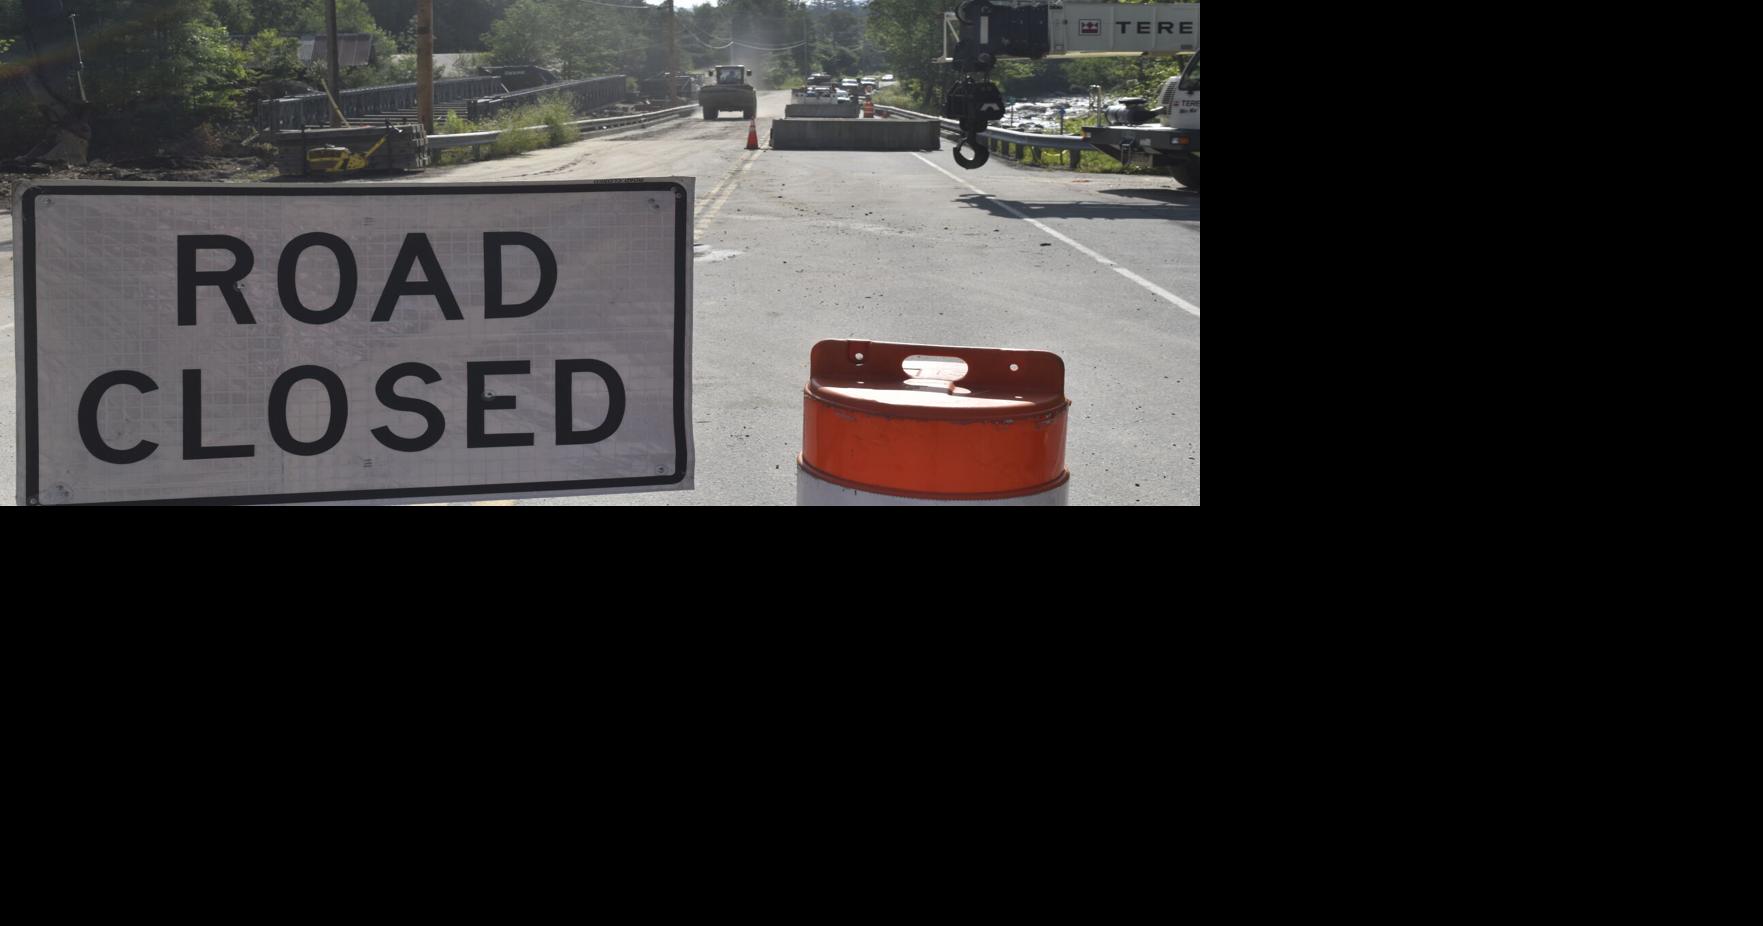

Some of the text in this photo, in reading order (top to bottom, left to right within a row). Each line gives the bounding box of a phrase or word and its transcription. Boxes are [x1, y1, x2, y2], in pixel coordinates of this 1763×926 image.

[1115, 21, 1193, 34] TERE
[177, 231, 558, 326] ROAD
[78, 359, 627, 464] CLOSED
